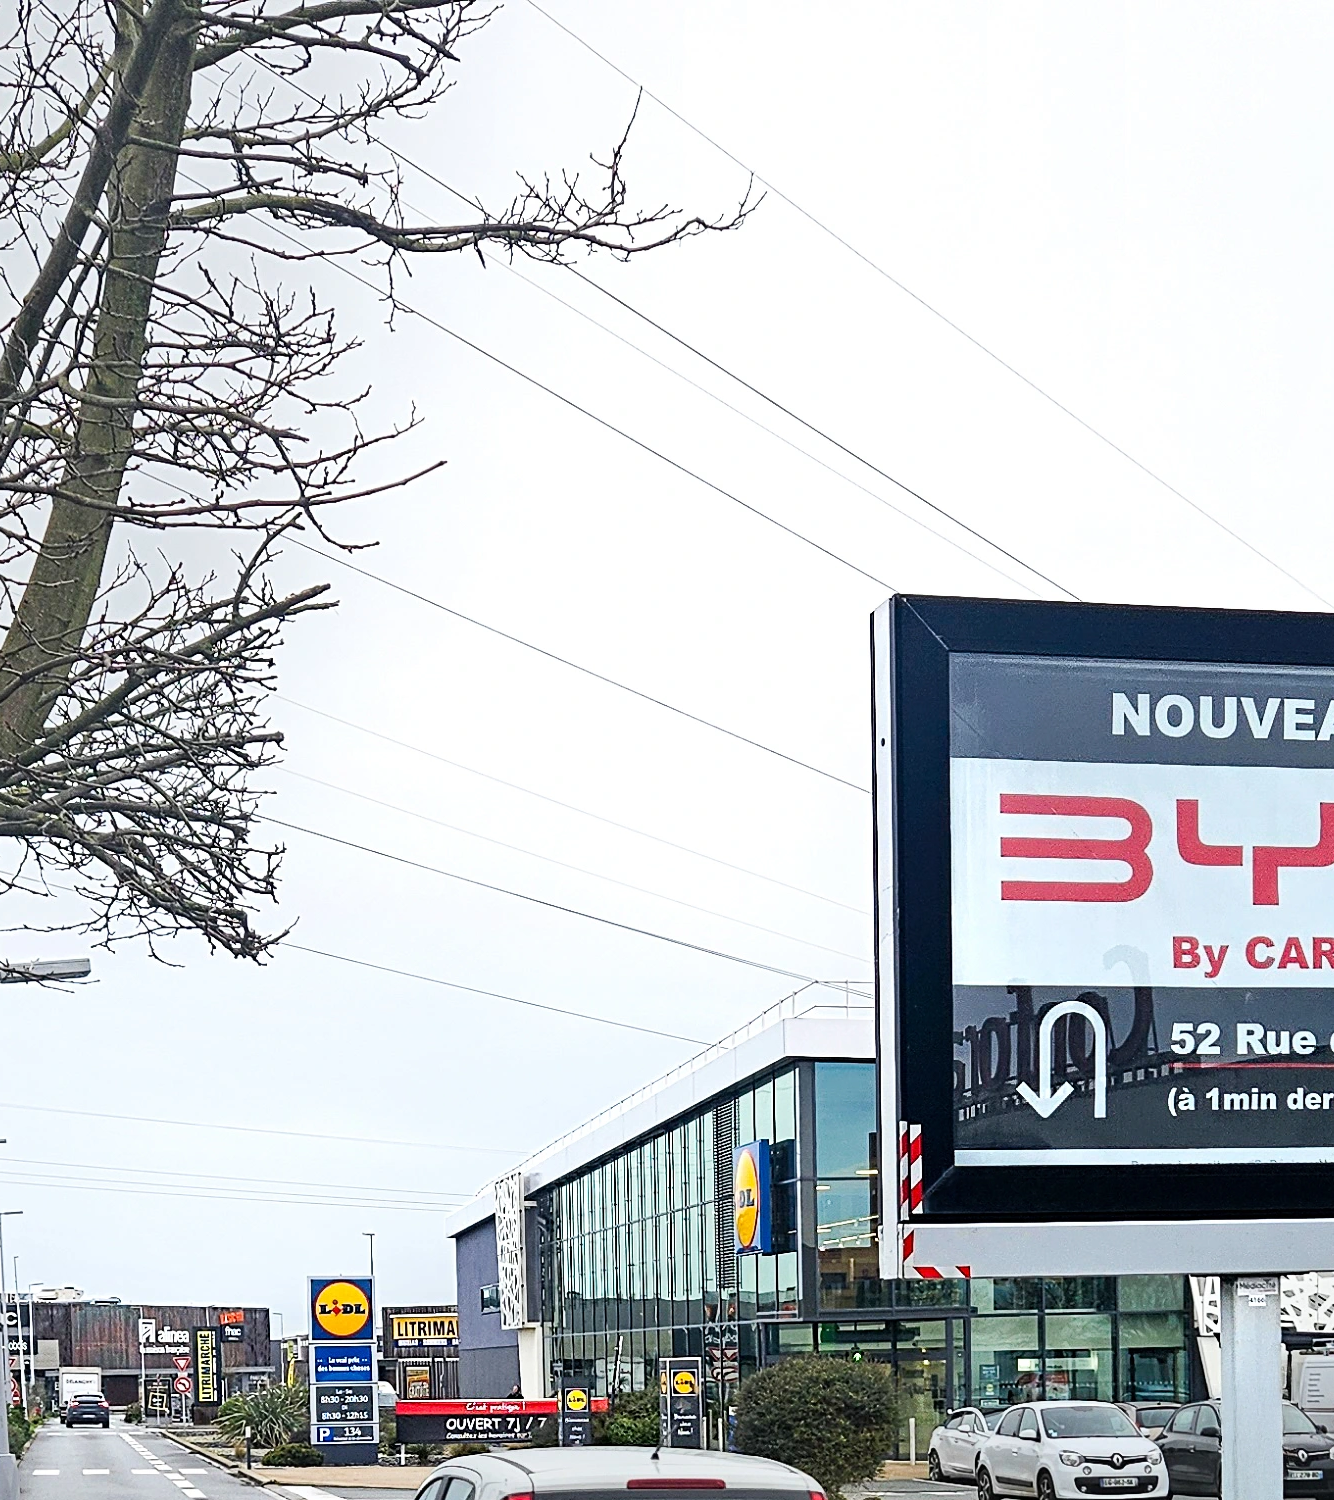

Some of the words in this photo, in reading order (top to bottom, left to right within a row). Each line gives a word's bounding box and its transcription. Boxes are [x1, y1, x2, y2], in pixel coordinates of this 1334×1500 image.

[1173, 936, 1229, 978] By
[1170, 1022, 1221, 1055] 52
[1236, 1022, 1316, 1055] Rue
[1167, 1086, 1195, 1117] (à
[1205, 1087, 1277, 1111] 1min
[224, 1325, 242, 1336] fnac
[397, 1320, 459, 1337] LITRIMA
[344, 1395, 369, 1403] 20h30
[321, 1411, 342, 1420] 8h30
[346, 1411, 369, 1420] 12h15
[445, 1417, 503, 1431] OUVERT
[537, 1417, 548, 1429] 7
[319, 1427, 331, 1442] P
[344, 1427, 362, 1437] 134
